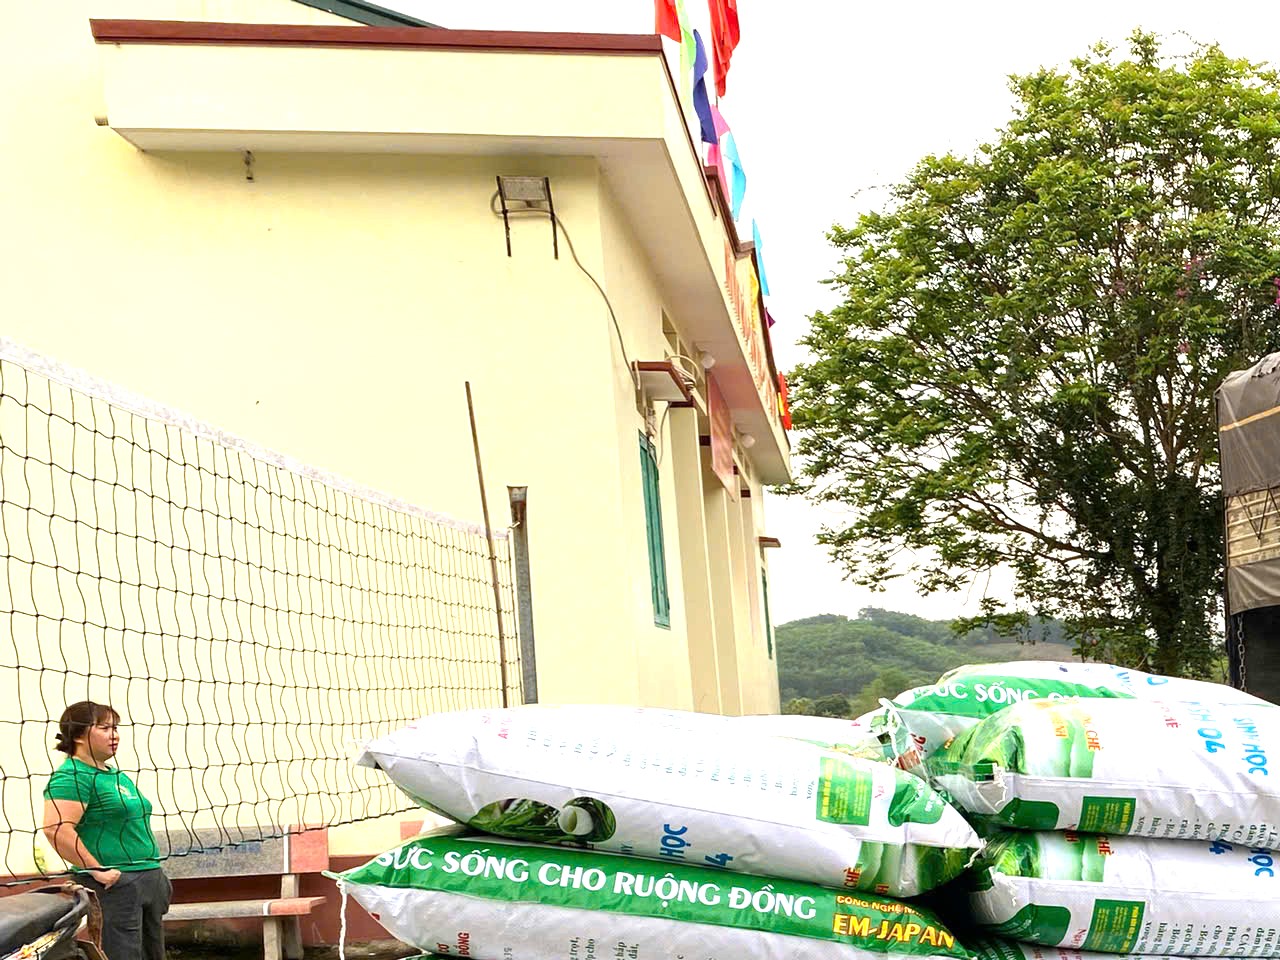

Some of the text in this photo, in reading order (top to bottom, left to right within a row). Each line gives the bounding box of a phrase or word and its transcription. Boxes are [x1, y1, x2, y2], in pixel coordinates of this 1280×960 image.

[1241, 743, 1269, 775] HỌC
[659, 822, 691, 861] HỌC
[441, 848, 530, 883] SỐNG
[537, 863, 607, 892] CHO
[613, 871, 720, 908] RUỘNG
[727, 885, 817, 921] ĐỒNG
[832, 912, 956, 949] EM-JAPAN
